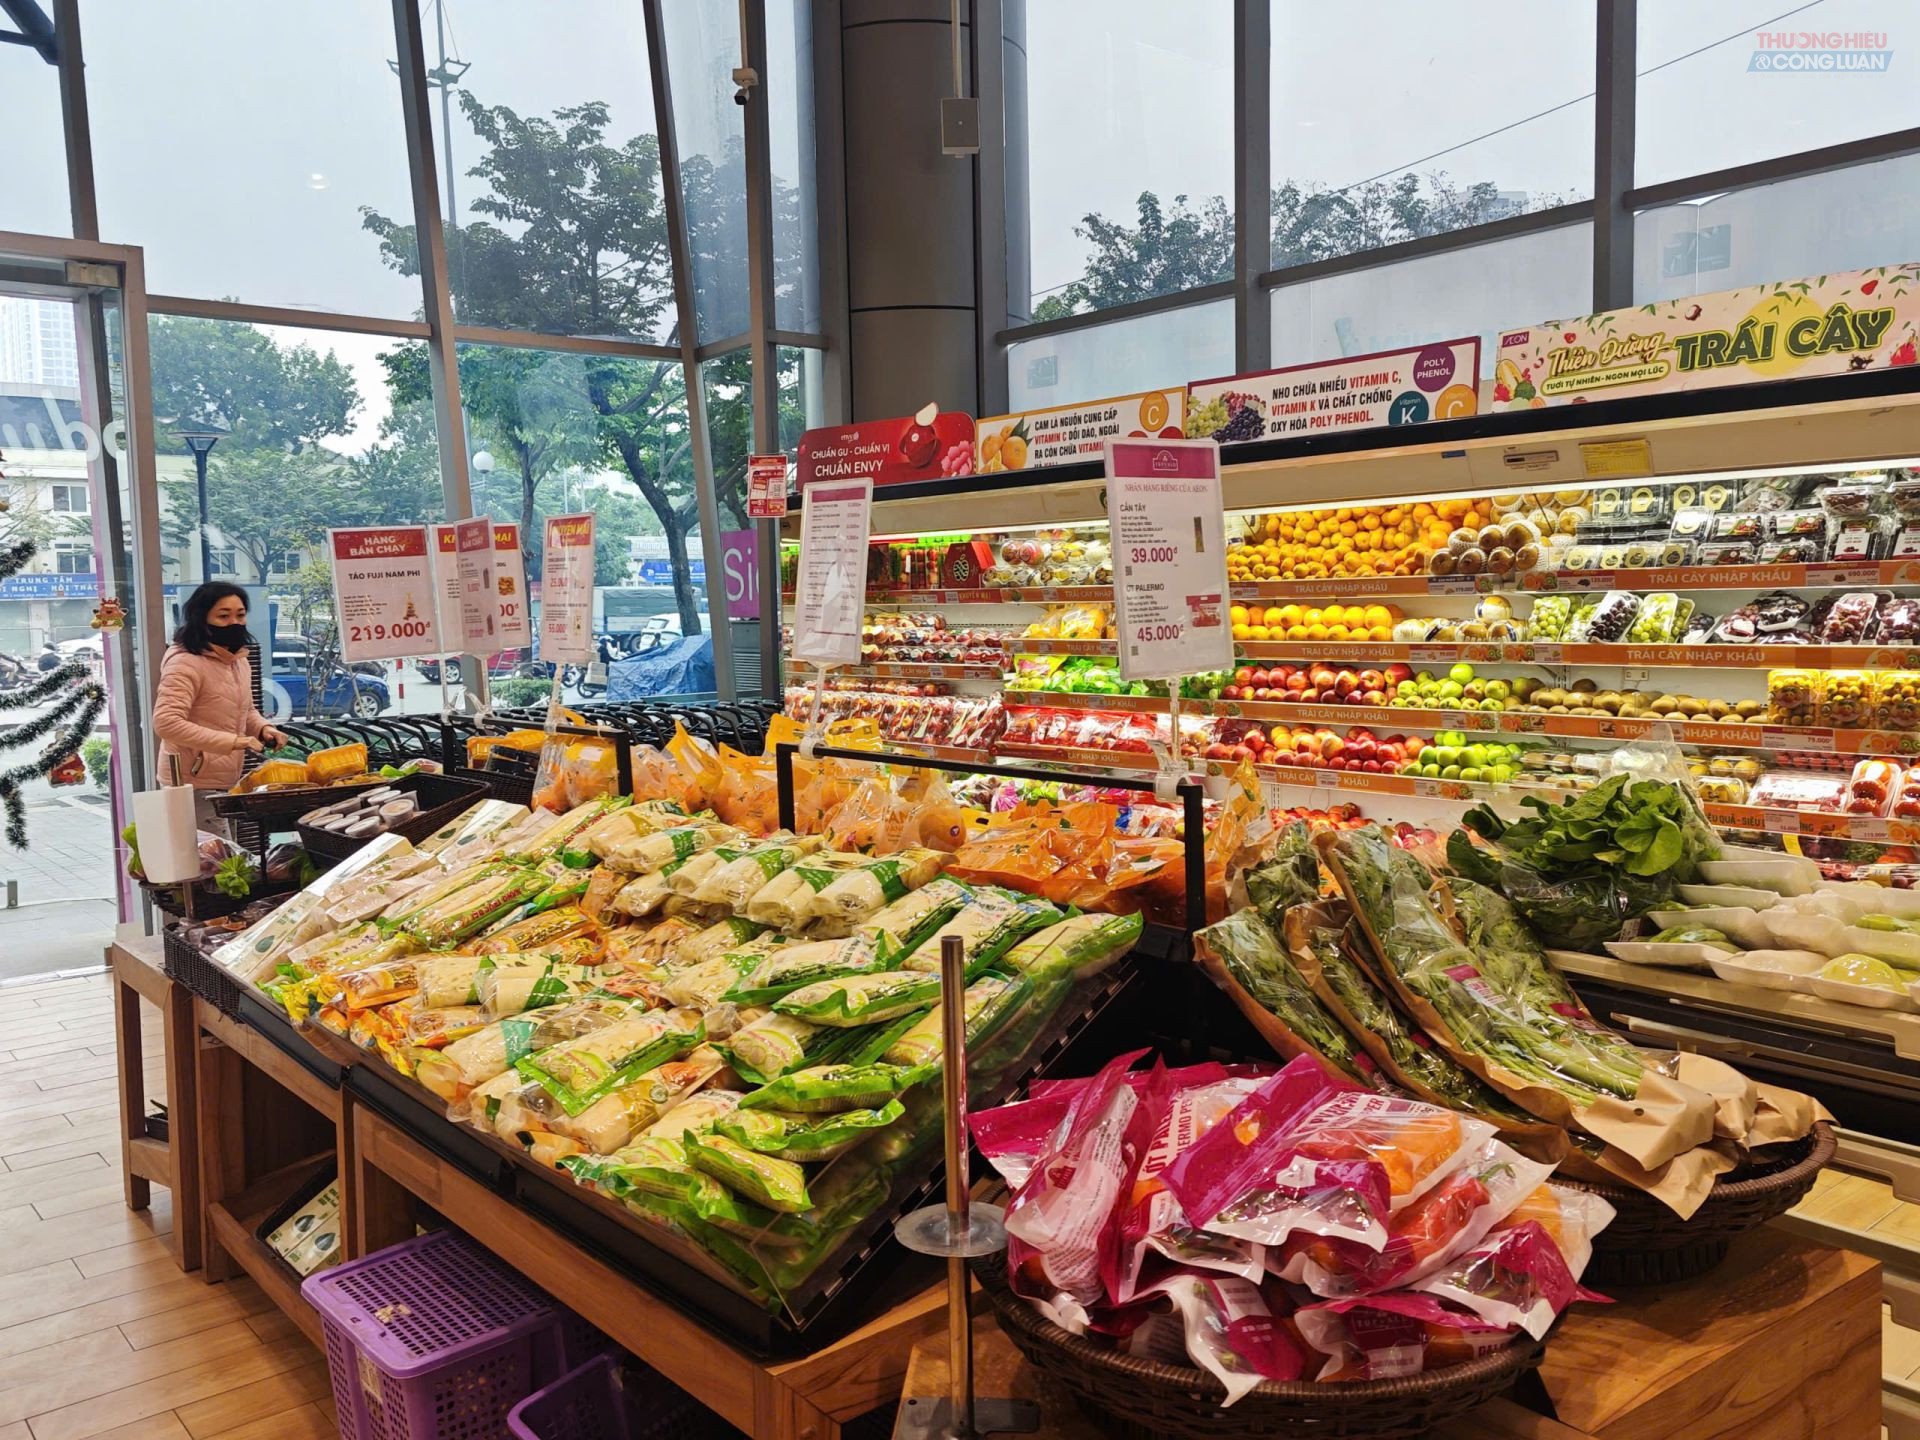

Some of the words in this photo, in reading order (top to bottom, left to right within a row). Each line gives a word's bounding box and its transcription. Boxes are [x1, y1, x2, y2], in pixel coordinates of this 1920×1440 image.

[1674, 319, 1778, 370] TRÁI
[1787, 303, 1895, 355] CÂY
[1424, 358, 1446, 368] POLY
[1417, 368, 1450, 379] PHENOL
[1272, 387, 1290, 400] NHO
[1292, 381, 1318, 398] CHỨA
[1319, 375, 1348, 394] NHIỀU
[1350, 373, 1390, 390] VITAMIN
[1272, 403, 1307, 416] VITAMIN
[1310, 400, 1316, 412] K
[1318, 393, 1330, 410] VÀ
[1332, 391, 1356, 408] CHẤT
[1360, 387, 1392, 406] CHỐNG
[1034, 420, 1049, 431] CAM
[1050, 416, 1058, 430] LÀ
[1060, 412, 1082, 428] NGUỒN
[1084, 411, 1102, 424] CUNG
[1104, 406, 1118, 422] CẤP
[1148, 405, 1160, 426] C
[1271, 420, 1288, 432] OXY
[1290, 414, 1308, 430] HÓA
[1310, 415, 1332, 429] POLY
[1334, 410, 1374, 426] PHENOL.
[1401, 406, 1417, 424] K
[1034, 432, 1061, 446] VITAMIN
[1062, 431, 1068, 442] C
[1068, 426, 1080, 440] DỒI
[1098, 424, 1120, 436] NGOÀI
[838, 448, 848, 456] GU
[882, 444, 890, 454] VỊ
[1034, 448, 1044, 460] RA
[1044, 446, 1058, 457] CÒN
[1059, 442, 1077, 456] CHỨA
[815, 458, 852, 477] CHUẨN
[854, 459, 884, 474] ENVY
[364, 534, 396, 546] HÀNG
[350, 546, 374, 556] BÁN
[376, 544, 406, 554] CHẠY
[386, 570, 405, 578] NAM
[724, 548, 759, 602] Si
[1649, 572, 1682, 584] TRÁI
[1684, 570, 1706, 583] CÂY
[1709, 572, 1748, 586] NHẬP
[1136, 583, 1164, 592] PALERMO
[1628, 648, 1656, 661] TRÁI
[1658, 648, 1682, 661] CÂY
[1685, 649, 1724, 663] NHẬP
